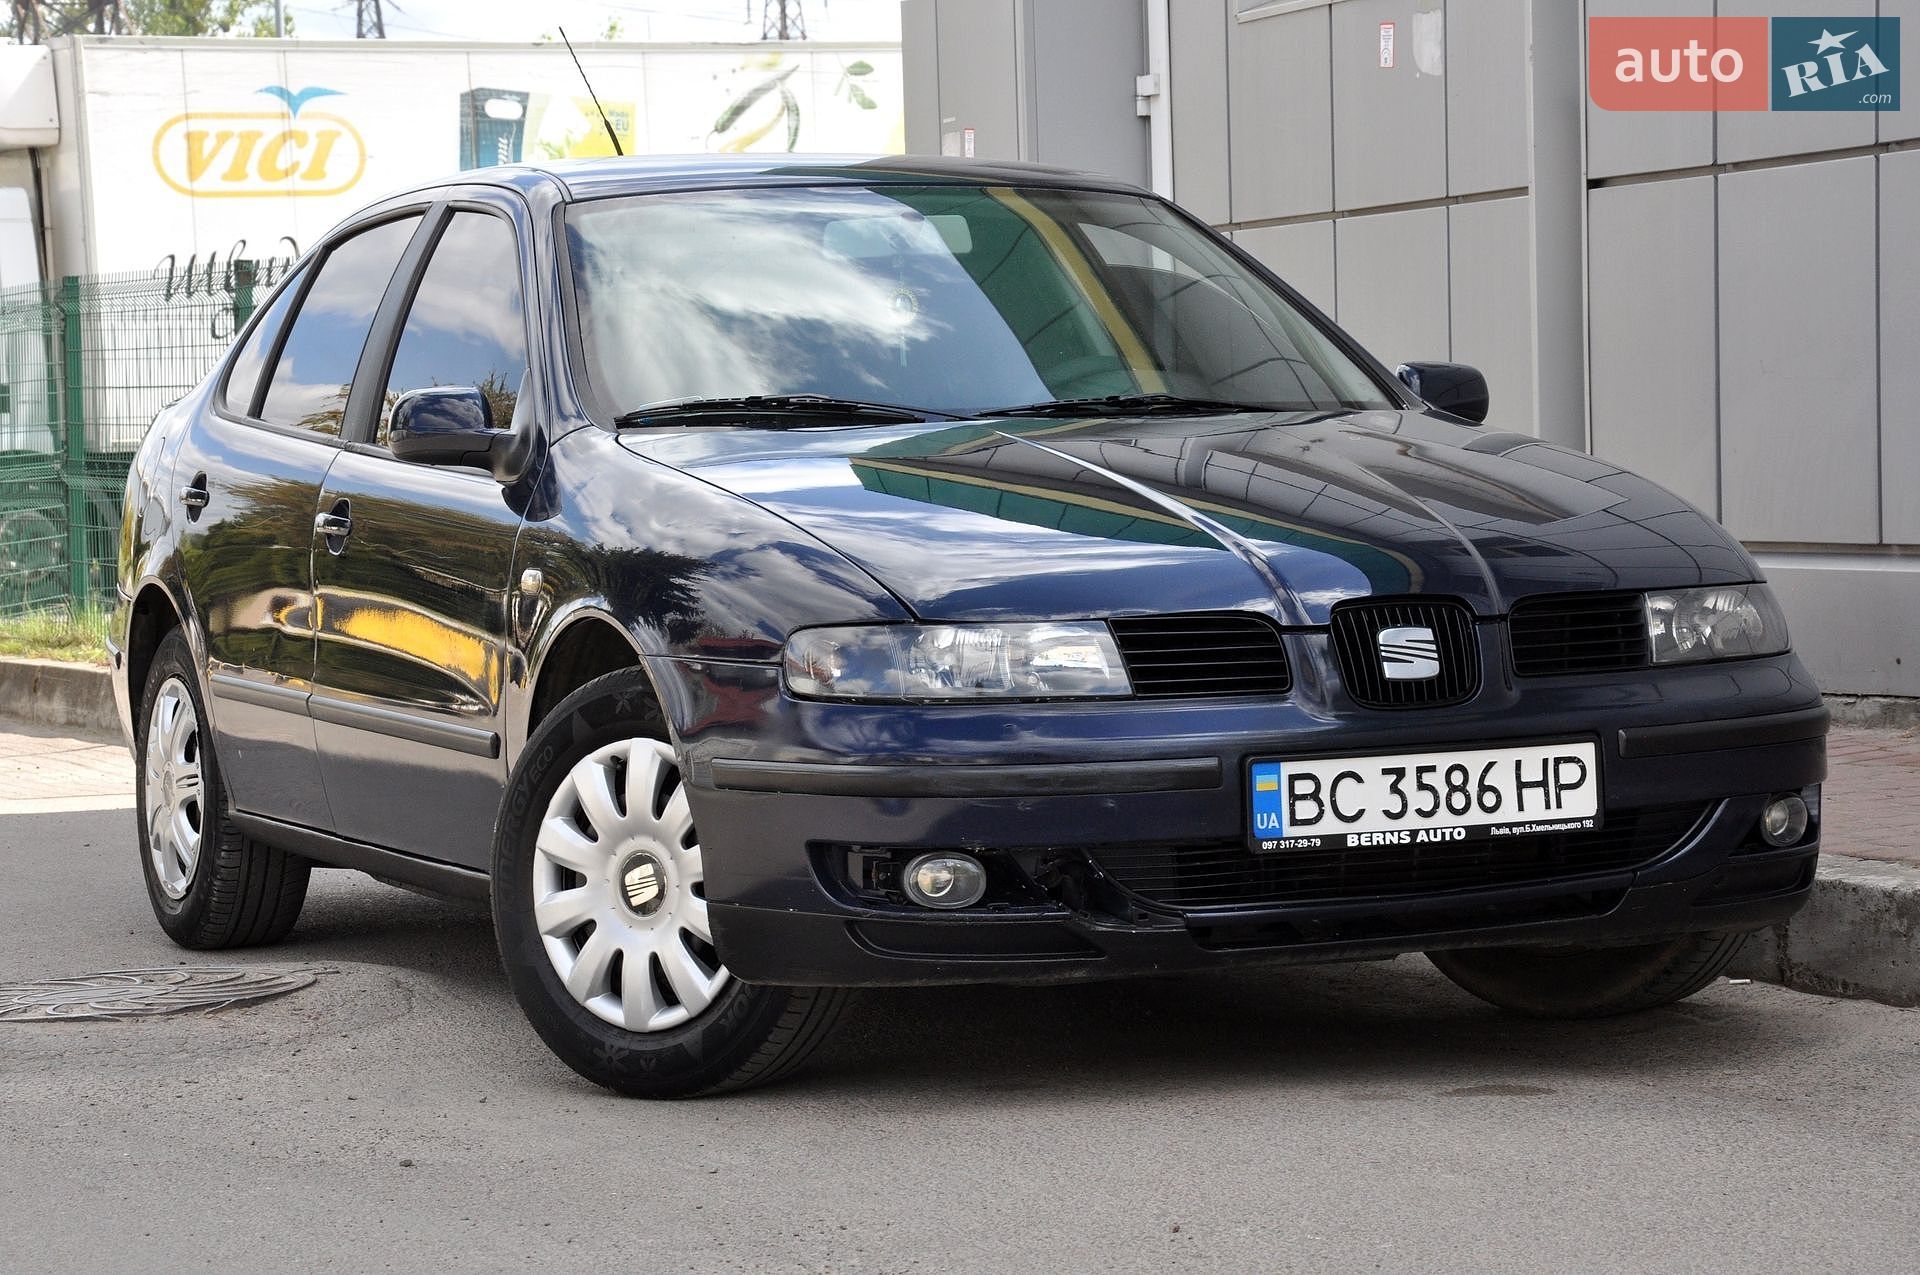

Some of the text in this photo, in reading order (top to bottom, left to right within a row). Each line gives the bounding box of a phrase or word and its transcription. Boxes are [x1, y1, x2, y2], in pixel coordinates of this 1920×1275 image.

[183, 129, 342, 183] VICI
[528, 744, 555, 784] ECO
[1288, 755, 1588, 827] BC 3586 HP
[1256, 813, 1280, 830] UA
[1582, 819, 1594, 828] 192
[1262, 838, 1321, 850] 097 317-29-79
[1346, 827, 1466, 848] BERNS AUTO
